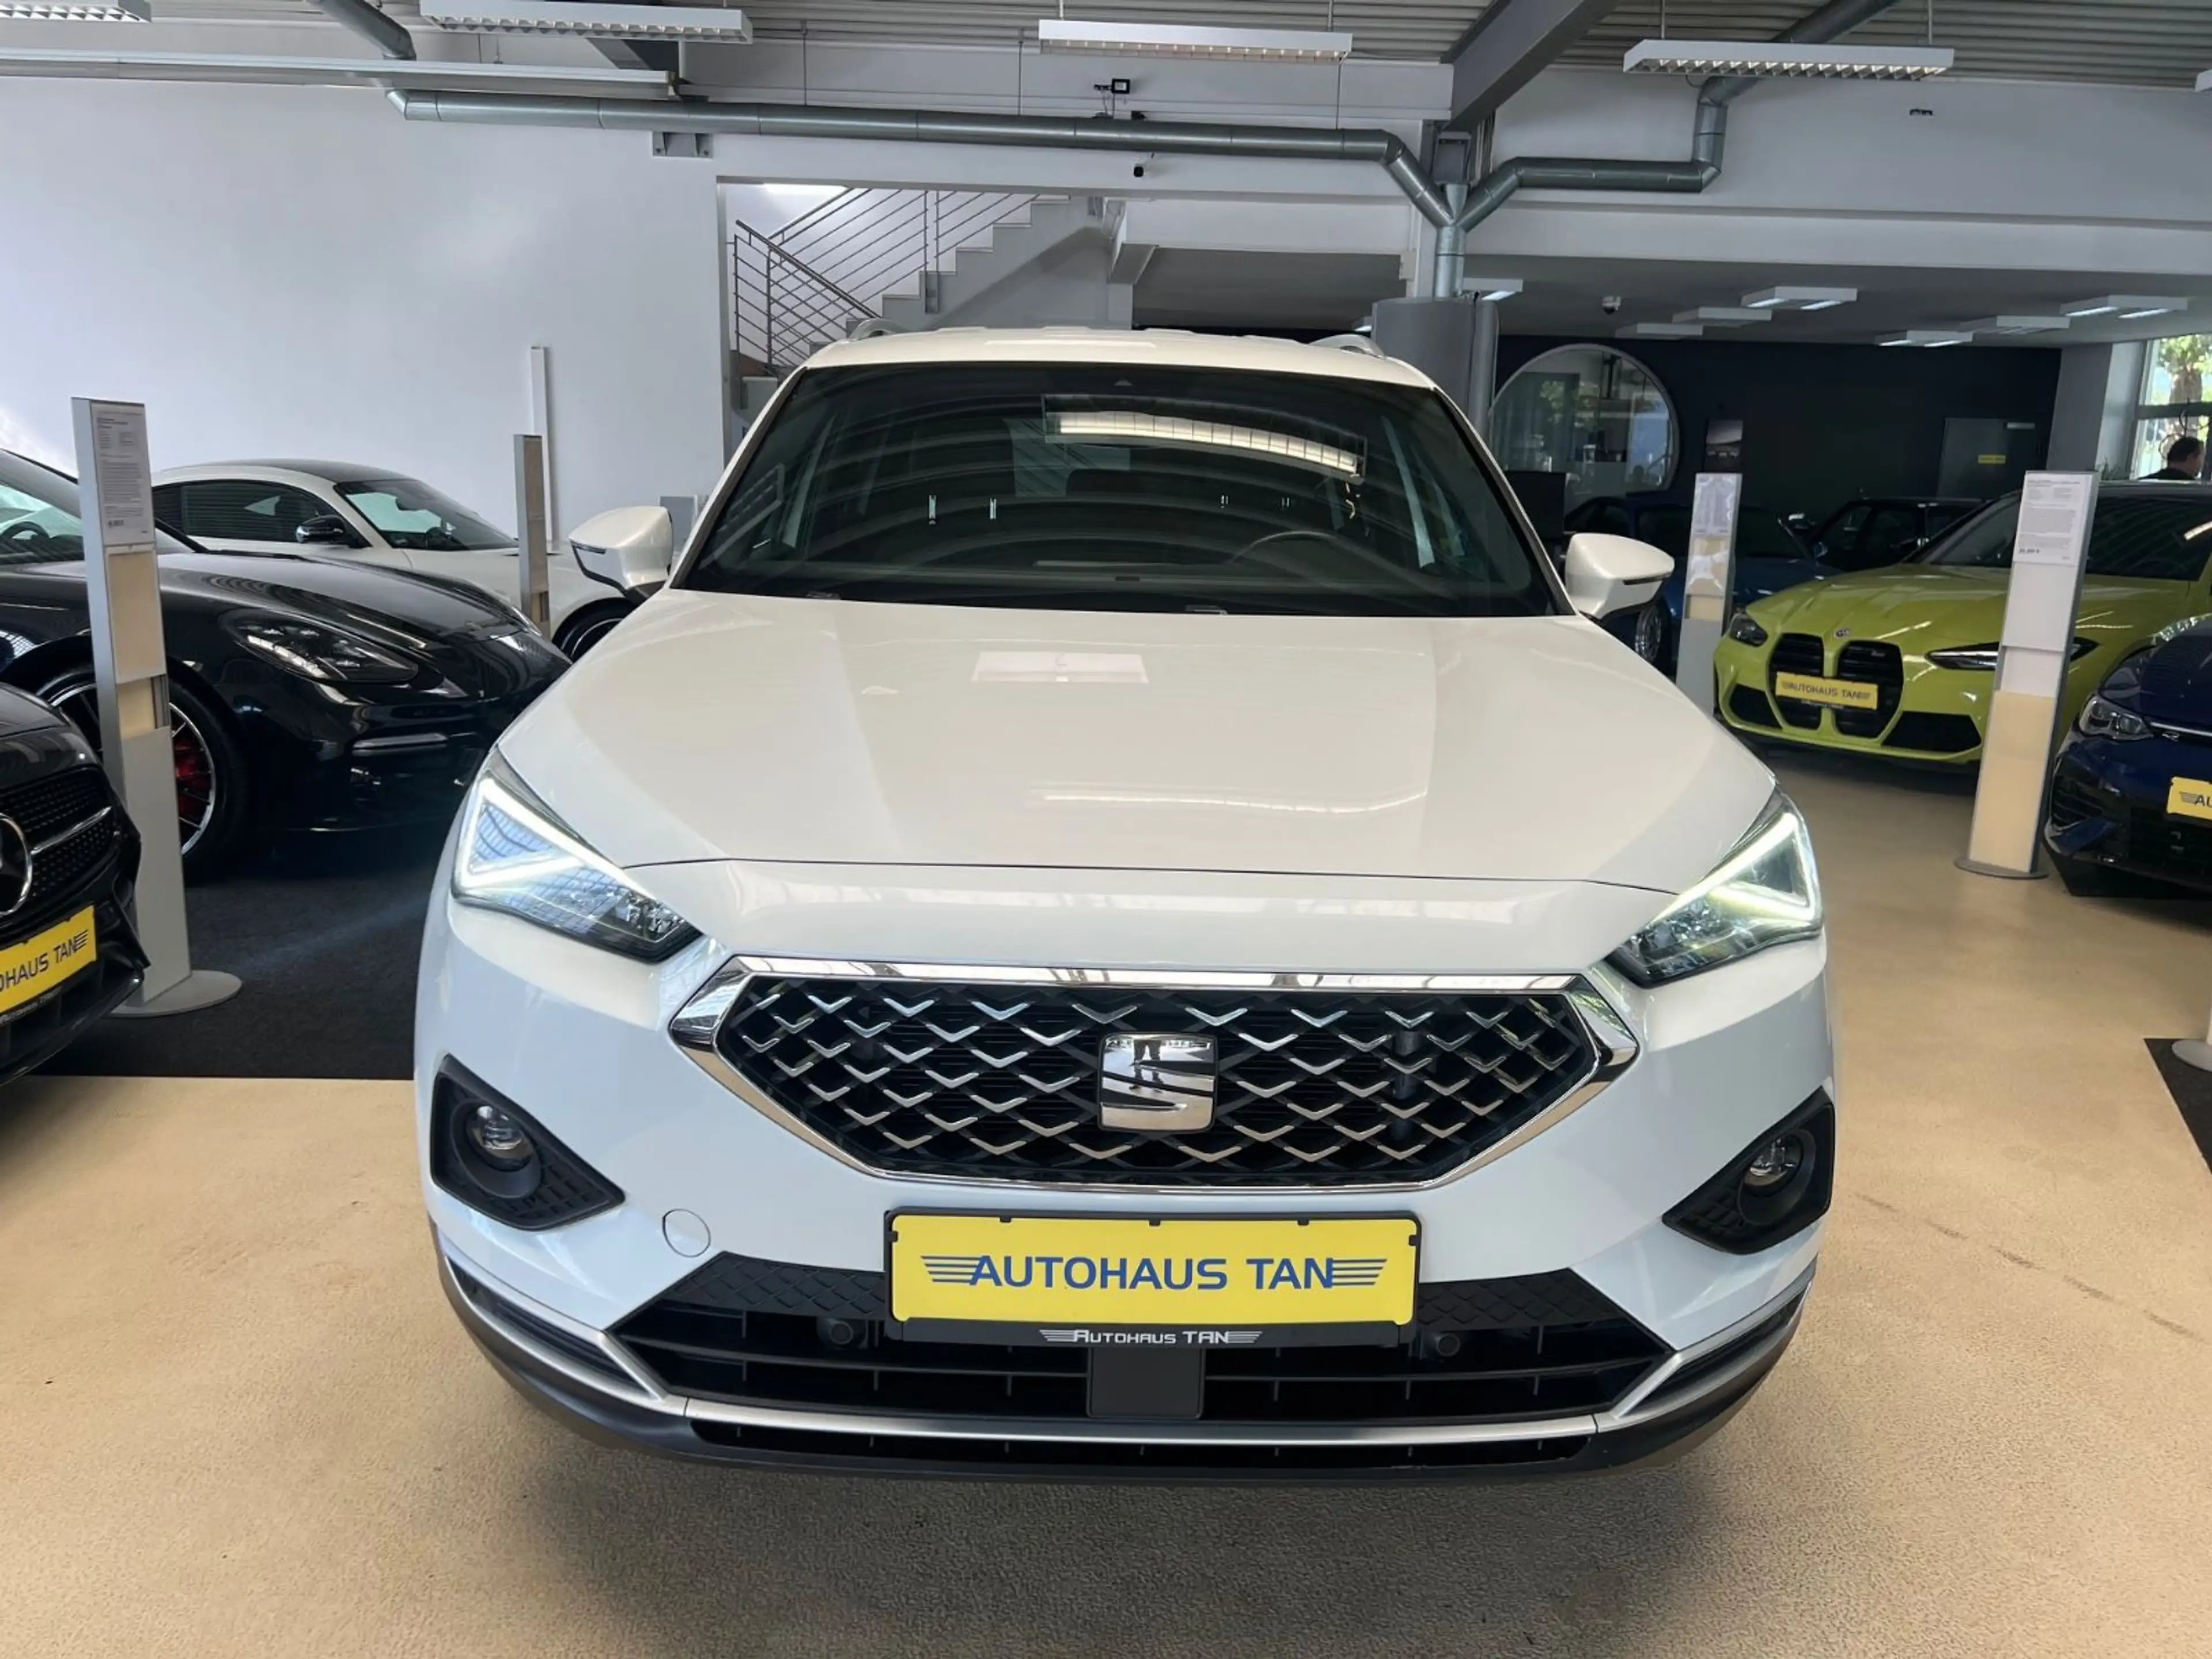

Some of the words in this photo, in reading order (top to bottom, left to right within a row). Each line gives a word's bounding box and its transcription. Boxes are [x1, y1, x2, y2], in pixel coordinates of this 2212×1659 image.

[54, 936, 77, 963] TAN
[969, 1255, 1228, 1290] AUTOHAUS
[1246, 1257, 1333, 1289] TAN
[1183, 1331, 1229, 1344] TAN
